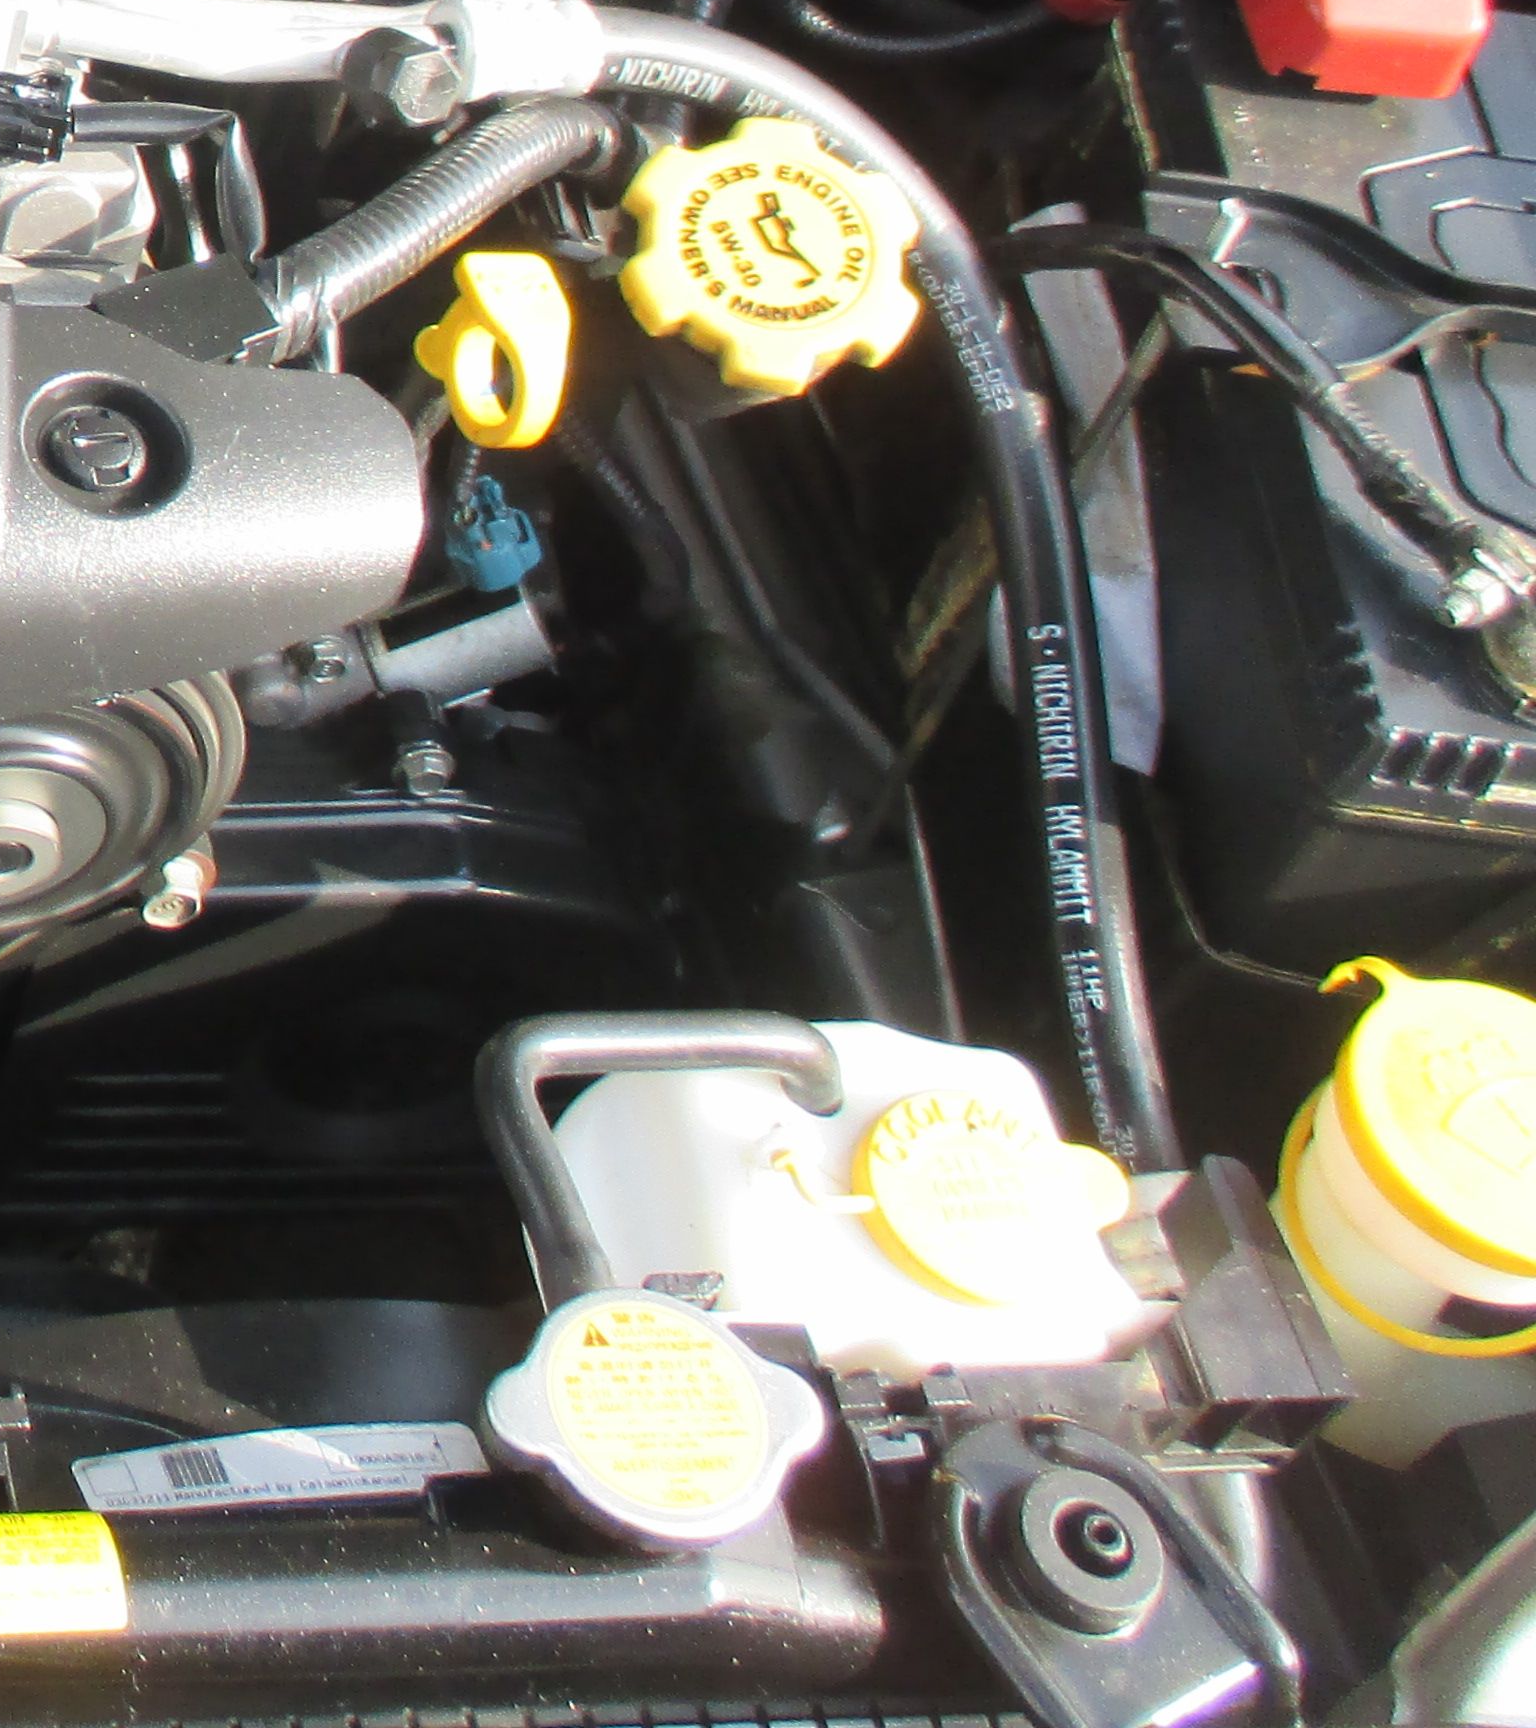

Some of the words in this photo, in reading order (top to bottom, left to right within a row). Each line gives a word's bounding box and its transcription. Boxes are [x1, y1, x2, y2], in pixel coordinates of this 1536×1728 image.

[710, 163, 760, 190] SEE
[775, 164, 861, 235] ENGINE
[836, 246, 865, 282] OIL
[1043, 803, 1092, 925] HYLAMMIT
